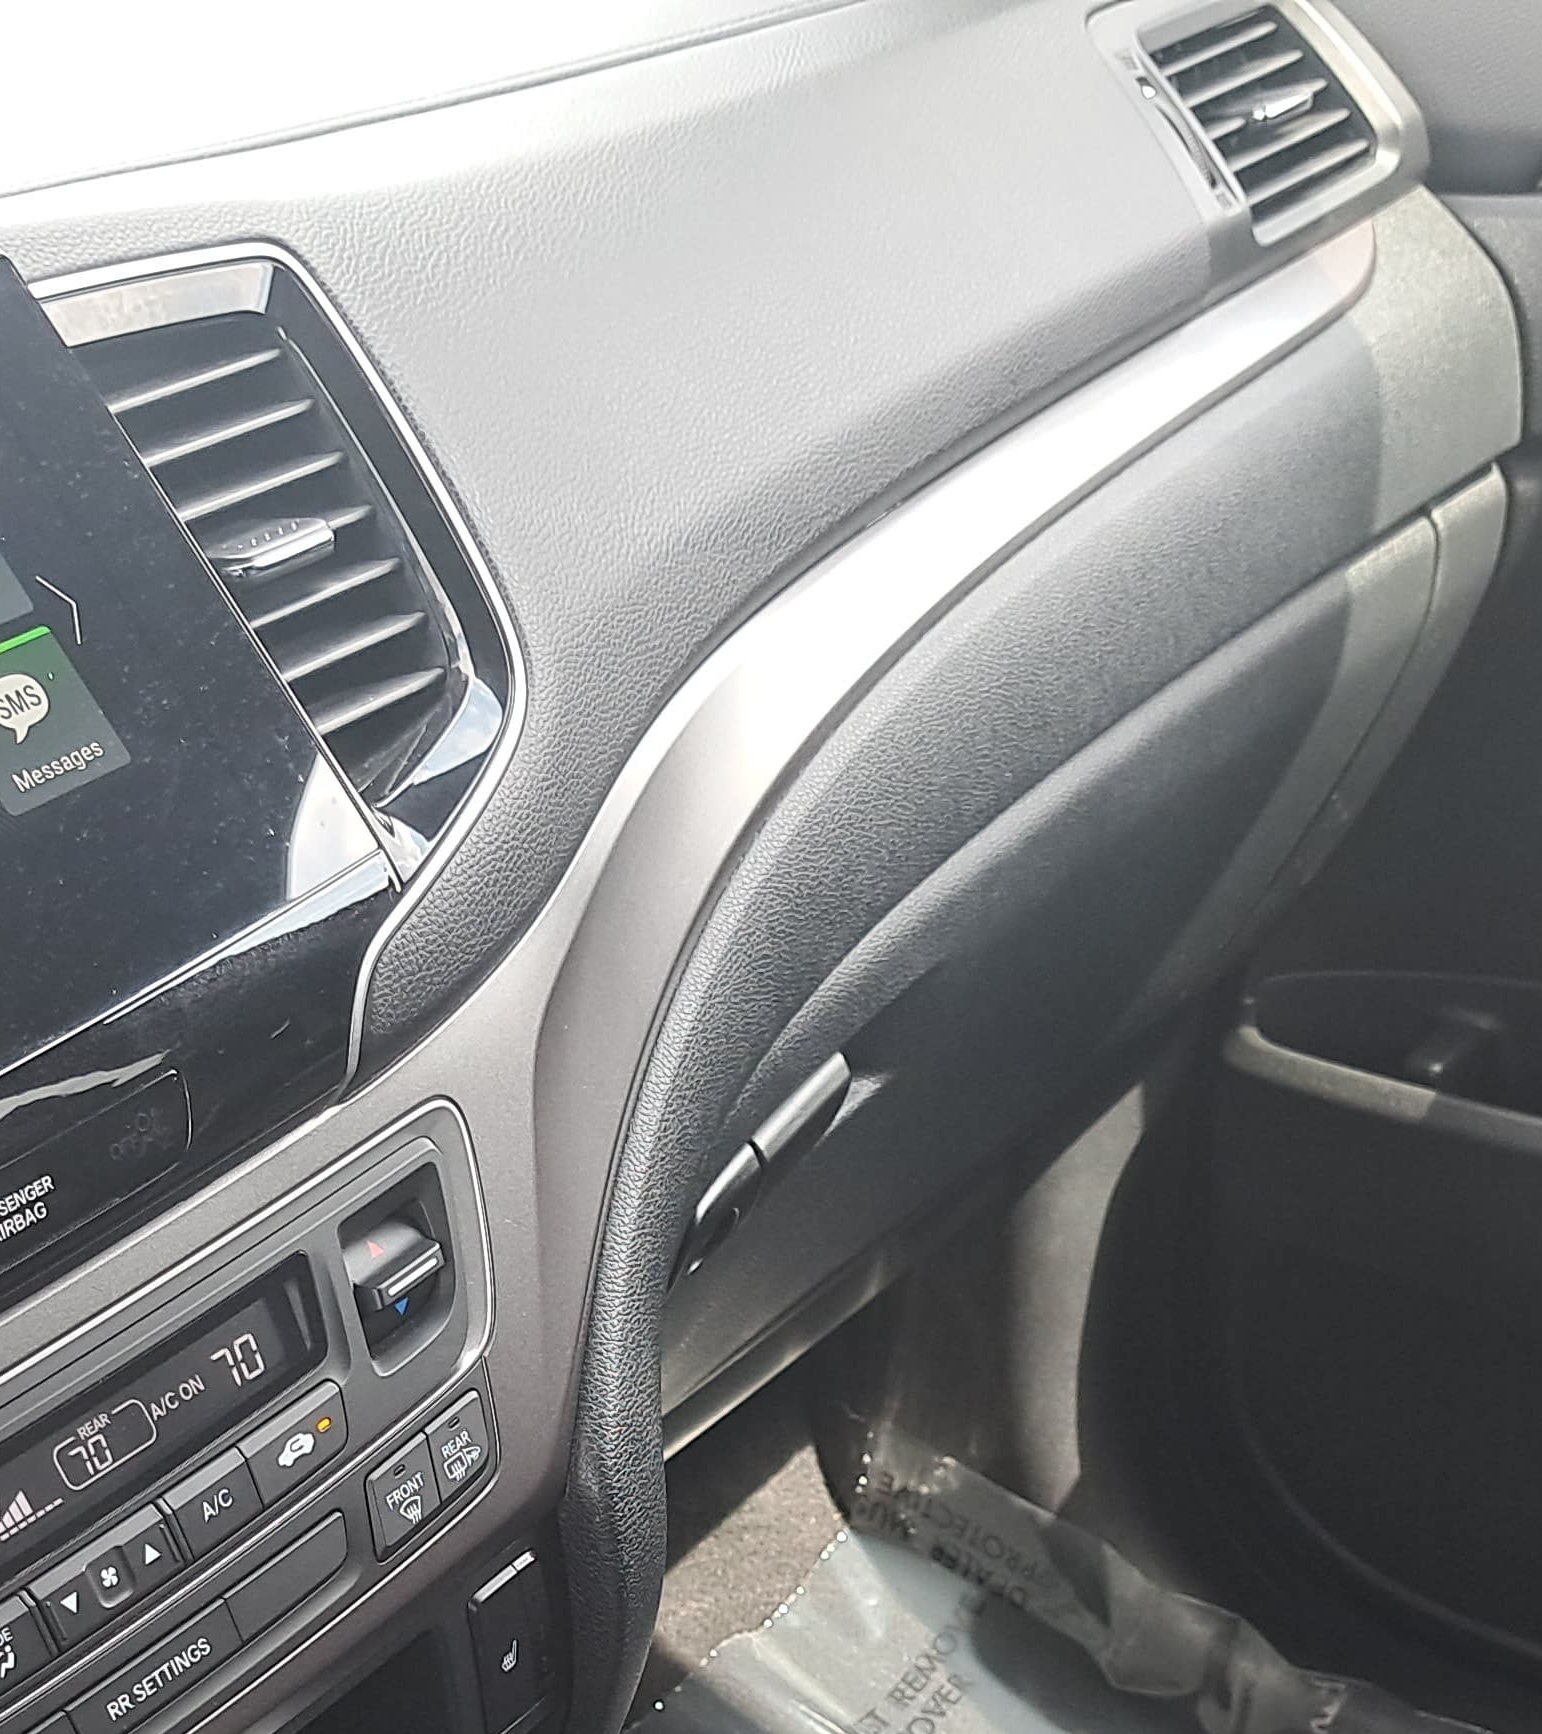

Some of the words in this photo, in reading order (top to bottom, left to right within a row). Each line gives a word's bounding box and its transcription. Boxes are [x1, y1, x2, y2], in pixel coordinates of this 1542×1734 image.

[11, 740, 104, 795] Messages
[210, 1333, 265, 1387] 70
[150, 1392, 180, 1421] A/C
[180, 1374, 205, 1401] ON
[76, 1413, 112, 1440] REAR
[441, 1430, 472, 1459] REAR
[67, 1434, 113, 1475] 70
[201, 1488, 234, 1523] A/C
[385, 1471, 426, 1512] FRONT
[105, 1693, 133, 1721] RR
[132, 1638, 212, 1702] SETTINGS
